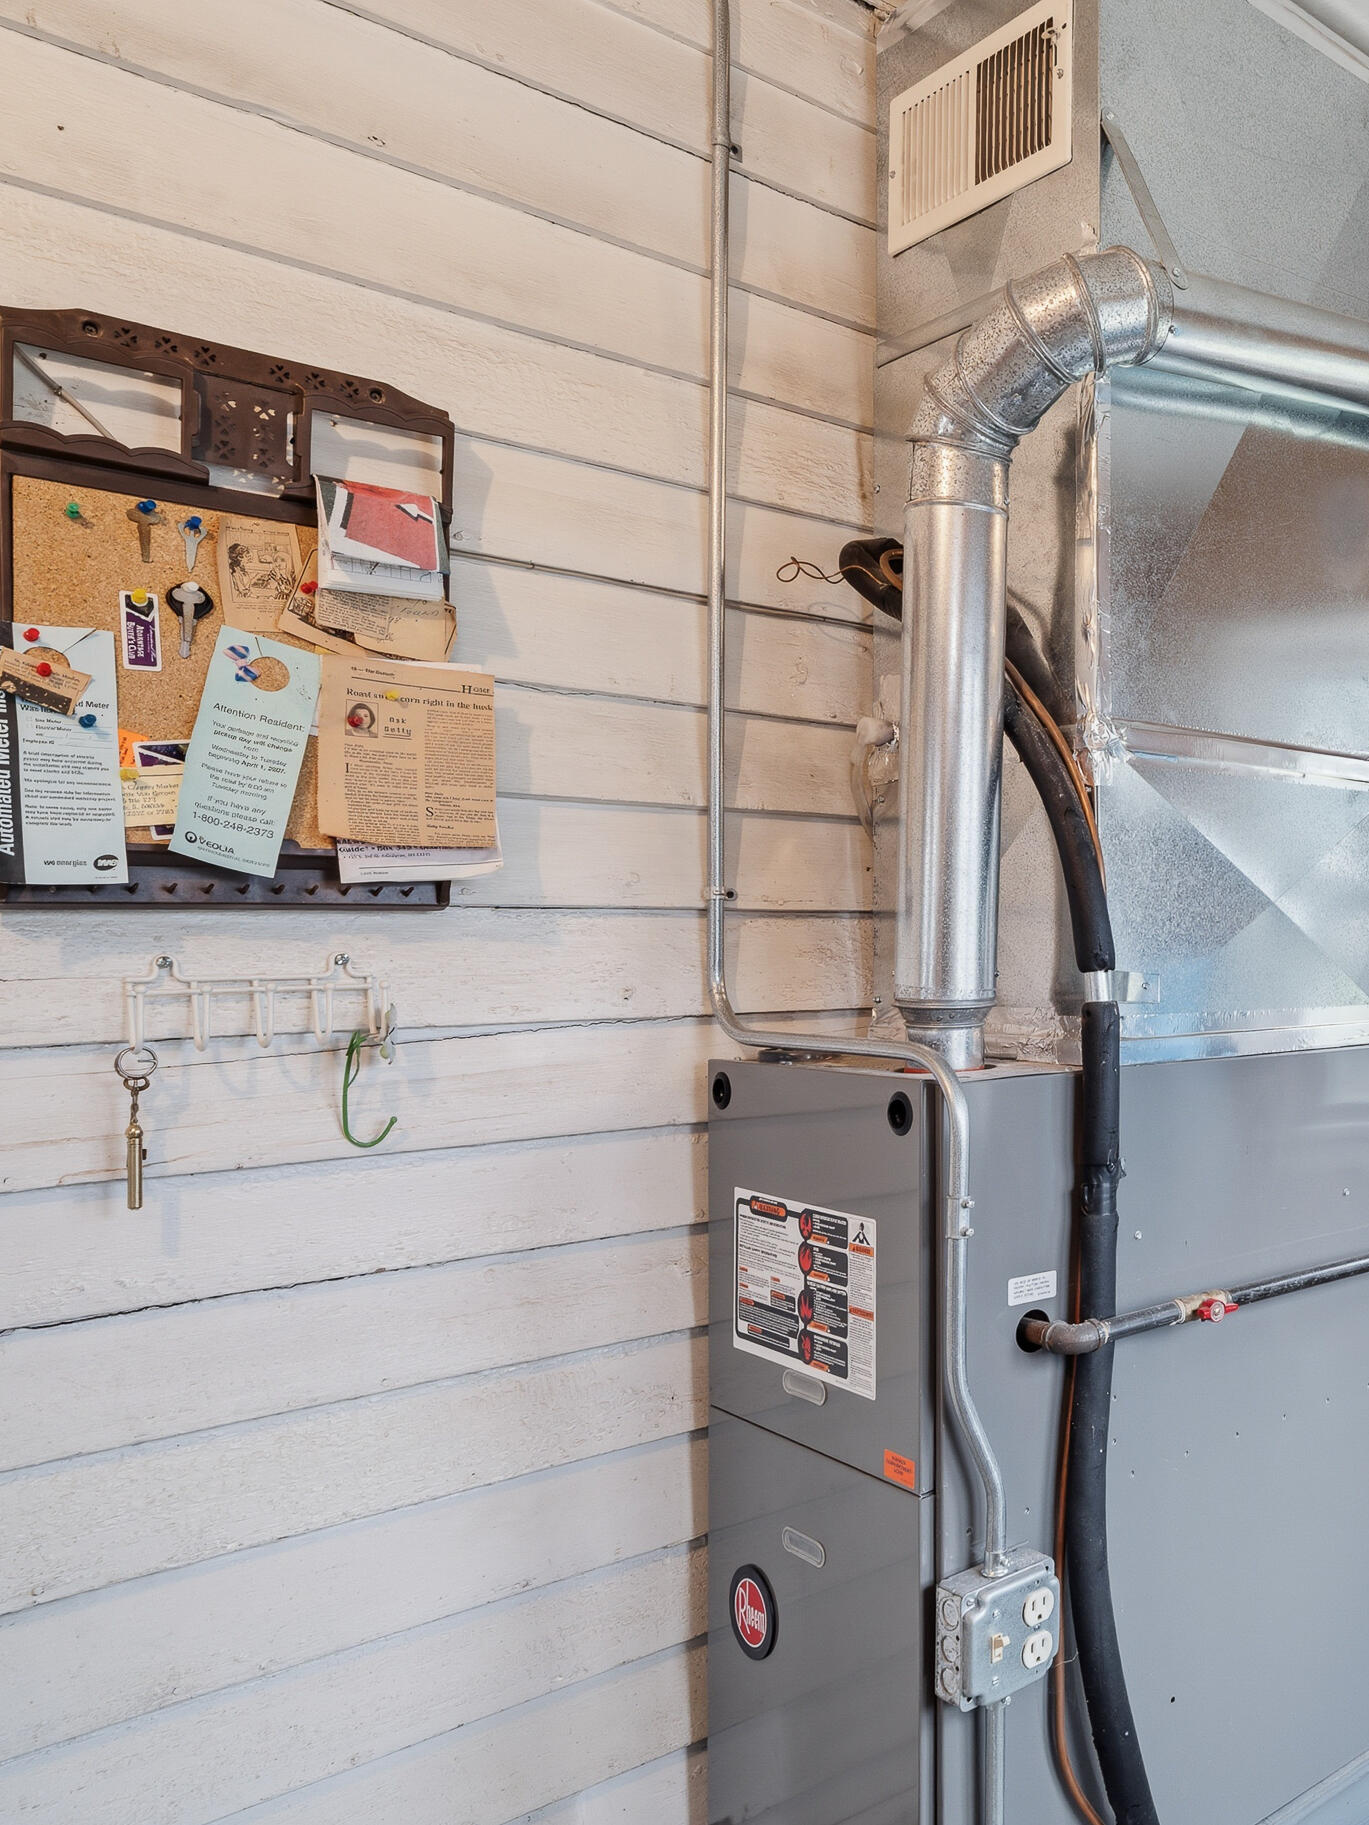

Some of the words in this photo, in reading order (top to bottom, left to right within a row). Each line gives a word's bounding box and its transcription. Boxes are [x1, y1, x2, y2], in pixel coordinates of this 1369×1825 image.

[86, 700, 109, 709] Meter
[347, 688, 371, 697] Roast
[400, 696, 420, 704] corn
[423, 698, 443, 707] right
[473, 703, 492, 711] husk
[213, 703, 256, 721] Attention
[260, 715, 305, 732] Resident:
[267, 743, 293, 753] change
[193, 811, 274, 839] 1-800-248-2373
[199, 837, 235, 854] VEOLIA
